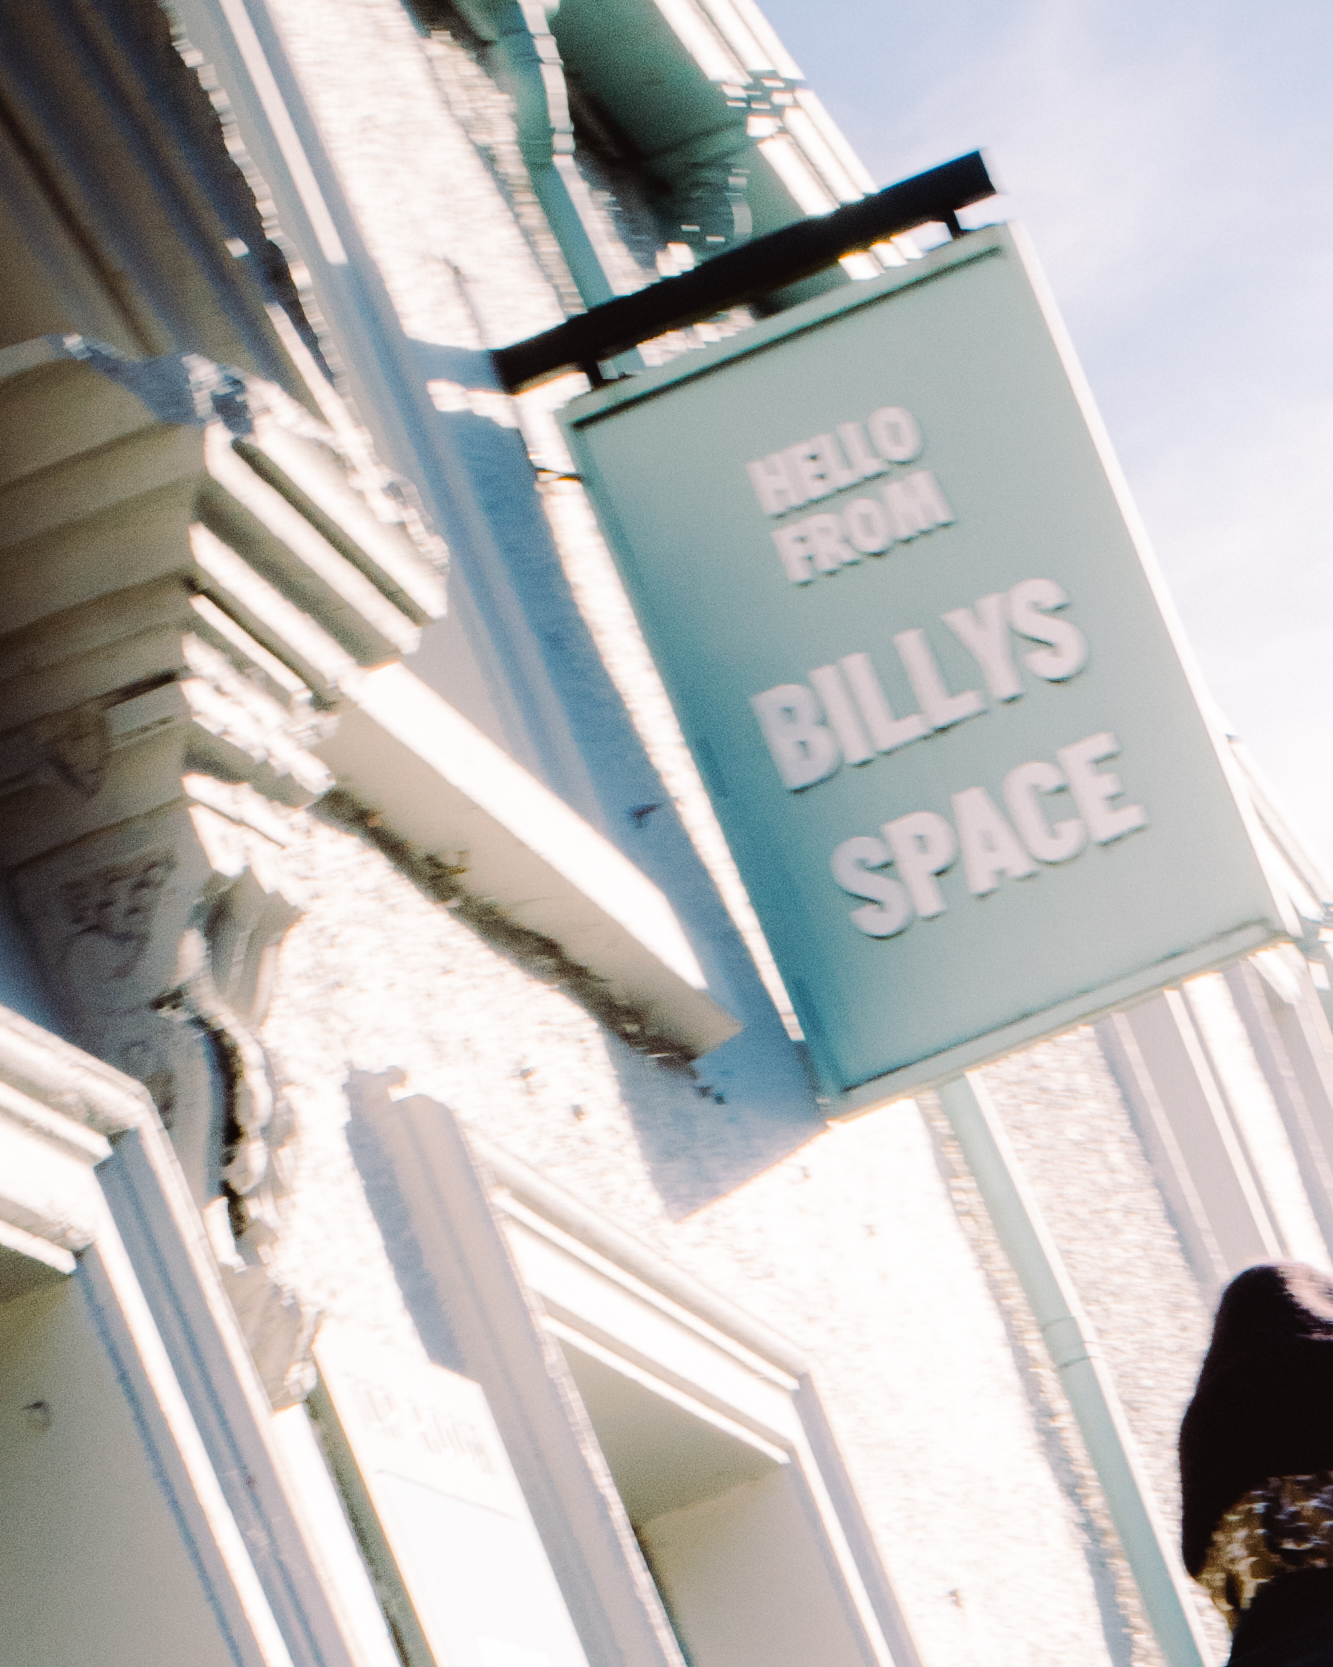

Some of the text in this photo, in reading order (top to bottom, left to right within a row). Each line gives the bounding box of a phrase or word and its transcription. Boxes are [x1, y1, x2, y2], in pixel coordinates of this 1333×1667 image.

[749, 407, 924, 516] HELLO
[772, 471, 954, 584] FROM
[751, 578, 1087, 792] BILLYS
[831, 732, 1147, 939] SPACE
